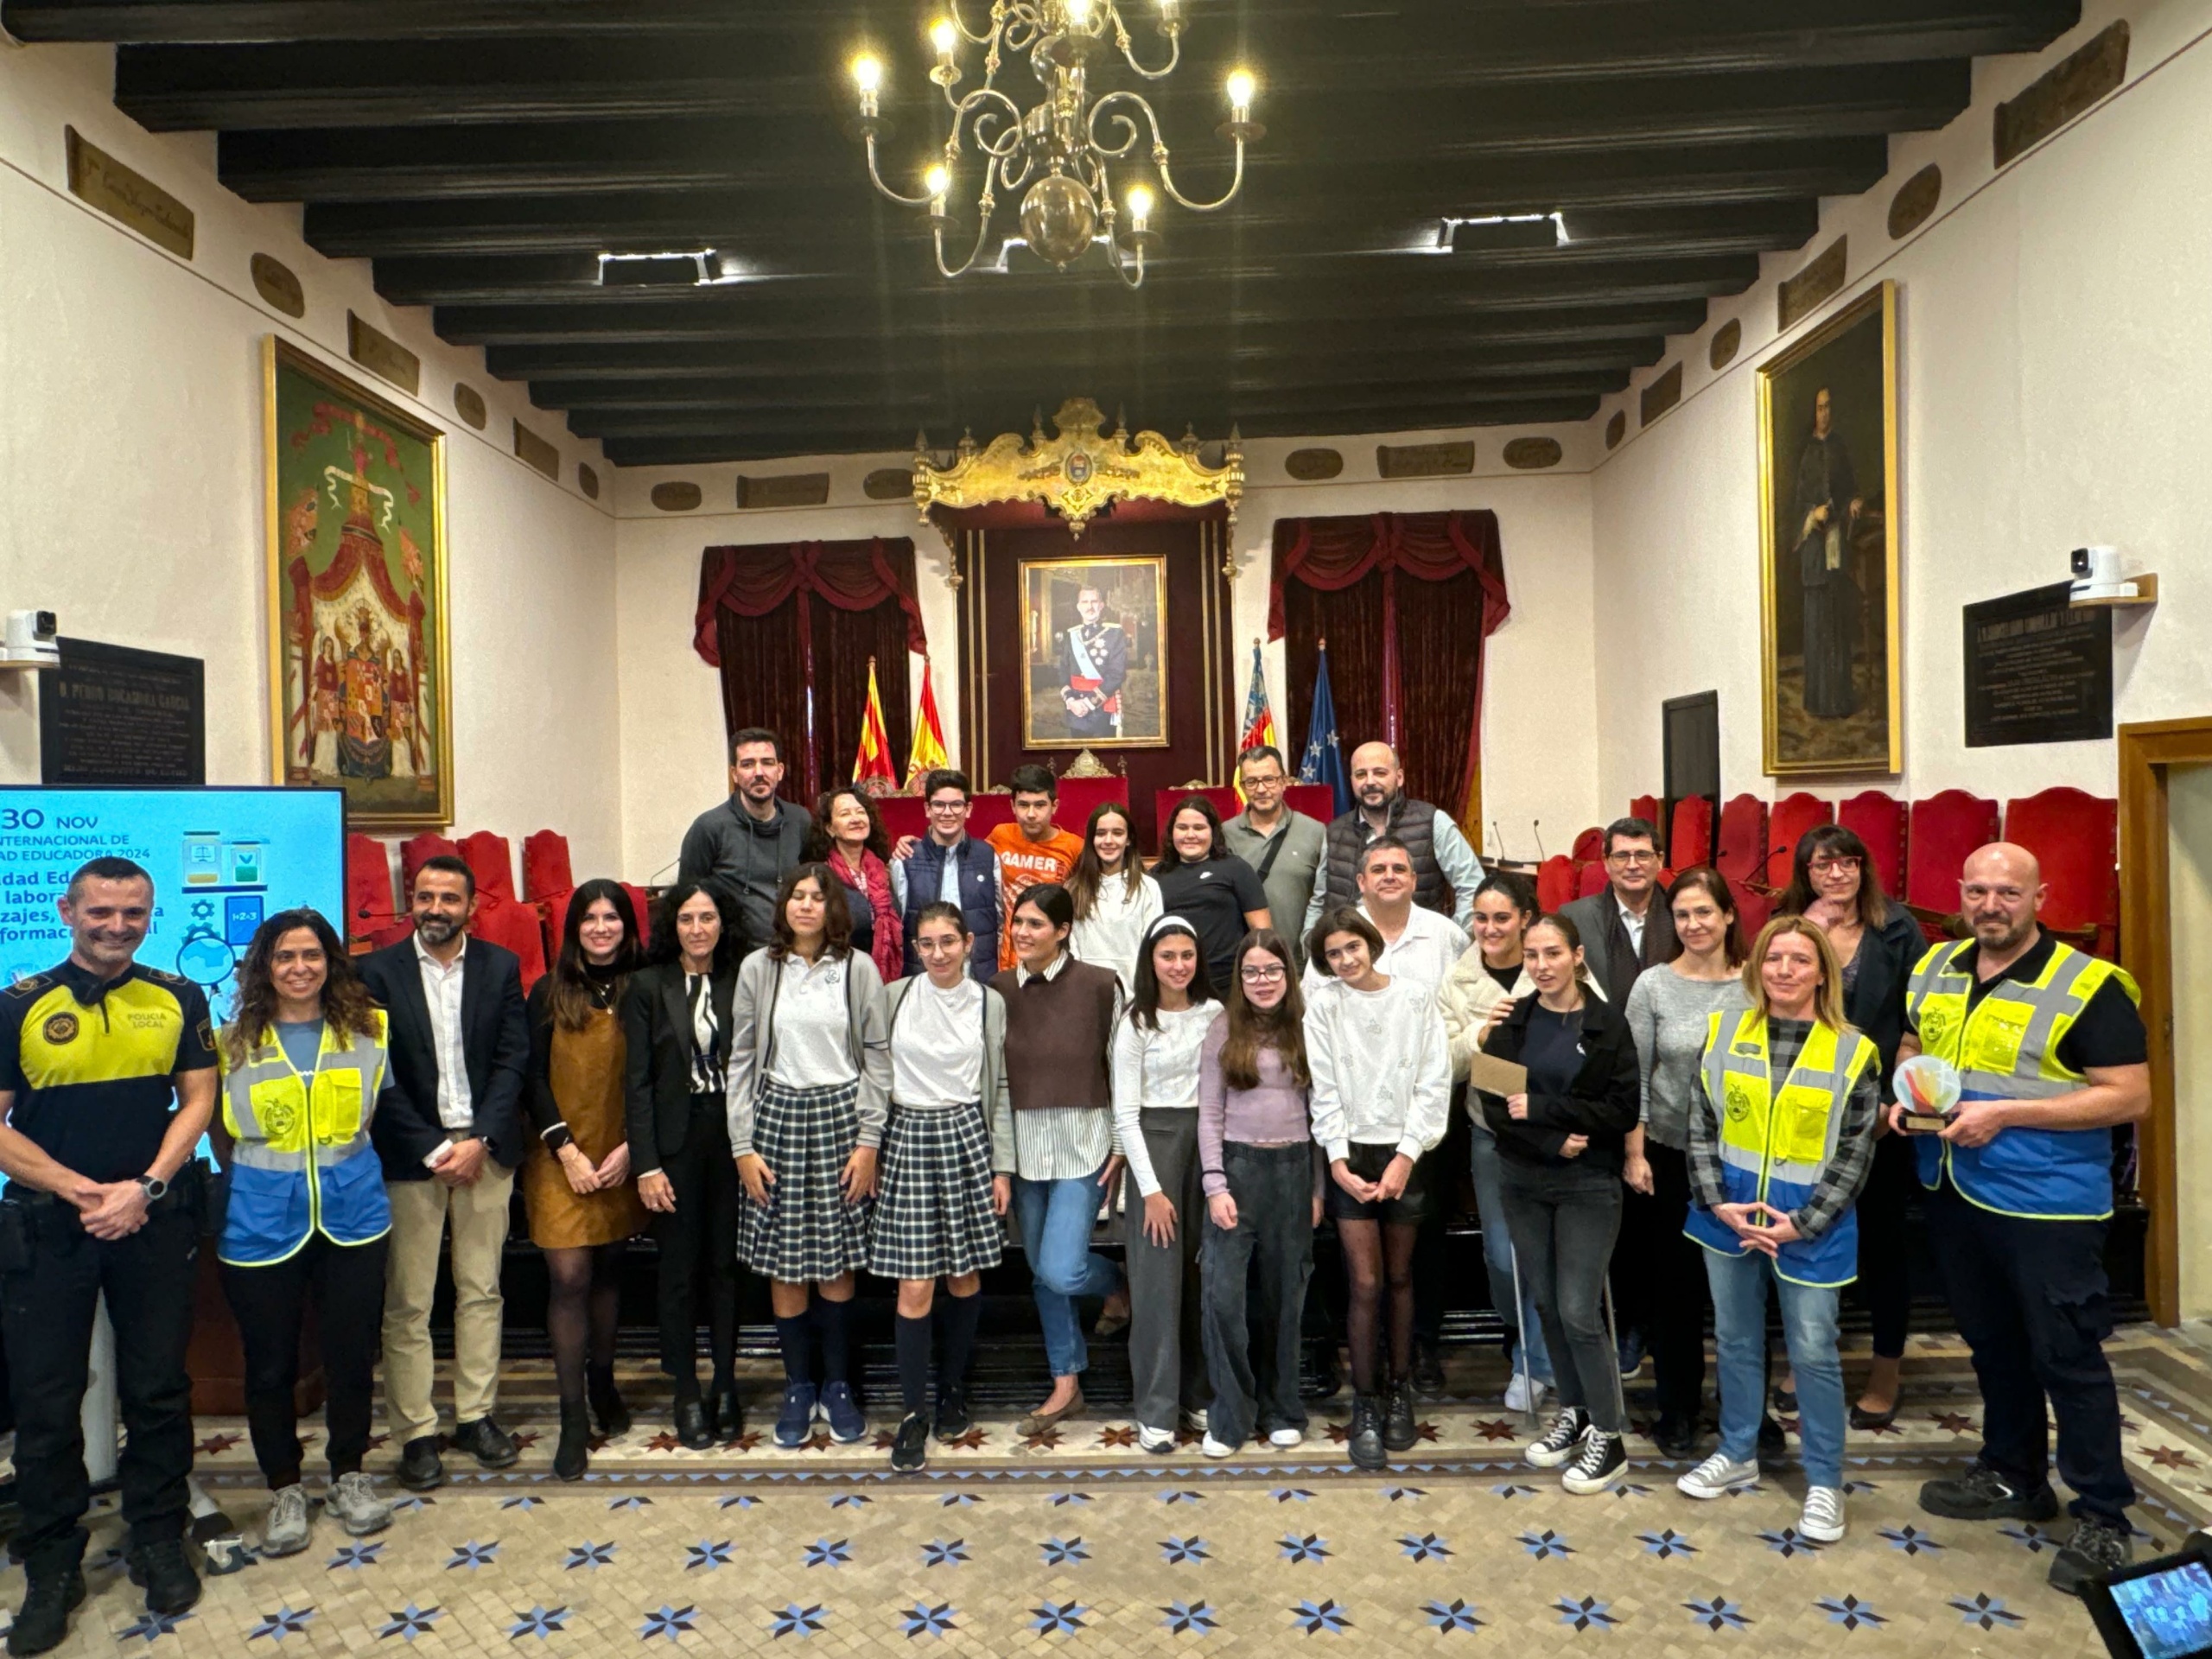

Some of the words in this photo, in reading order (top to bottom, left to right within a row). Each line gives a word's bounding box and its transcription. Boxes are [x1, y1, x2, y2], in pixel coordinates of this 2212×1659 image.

[1, 809, 44, 830] 30
[56, 817, 98, 829] NOV
[111, 835, 130, 845] DE
[1001, 851, 1056, 872] GAMER
[0, 871, 39, 886] dad
